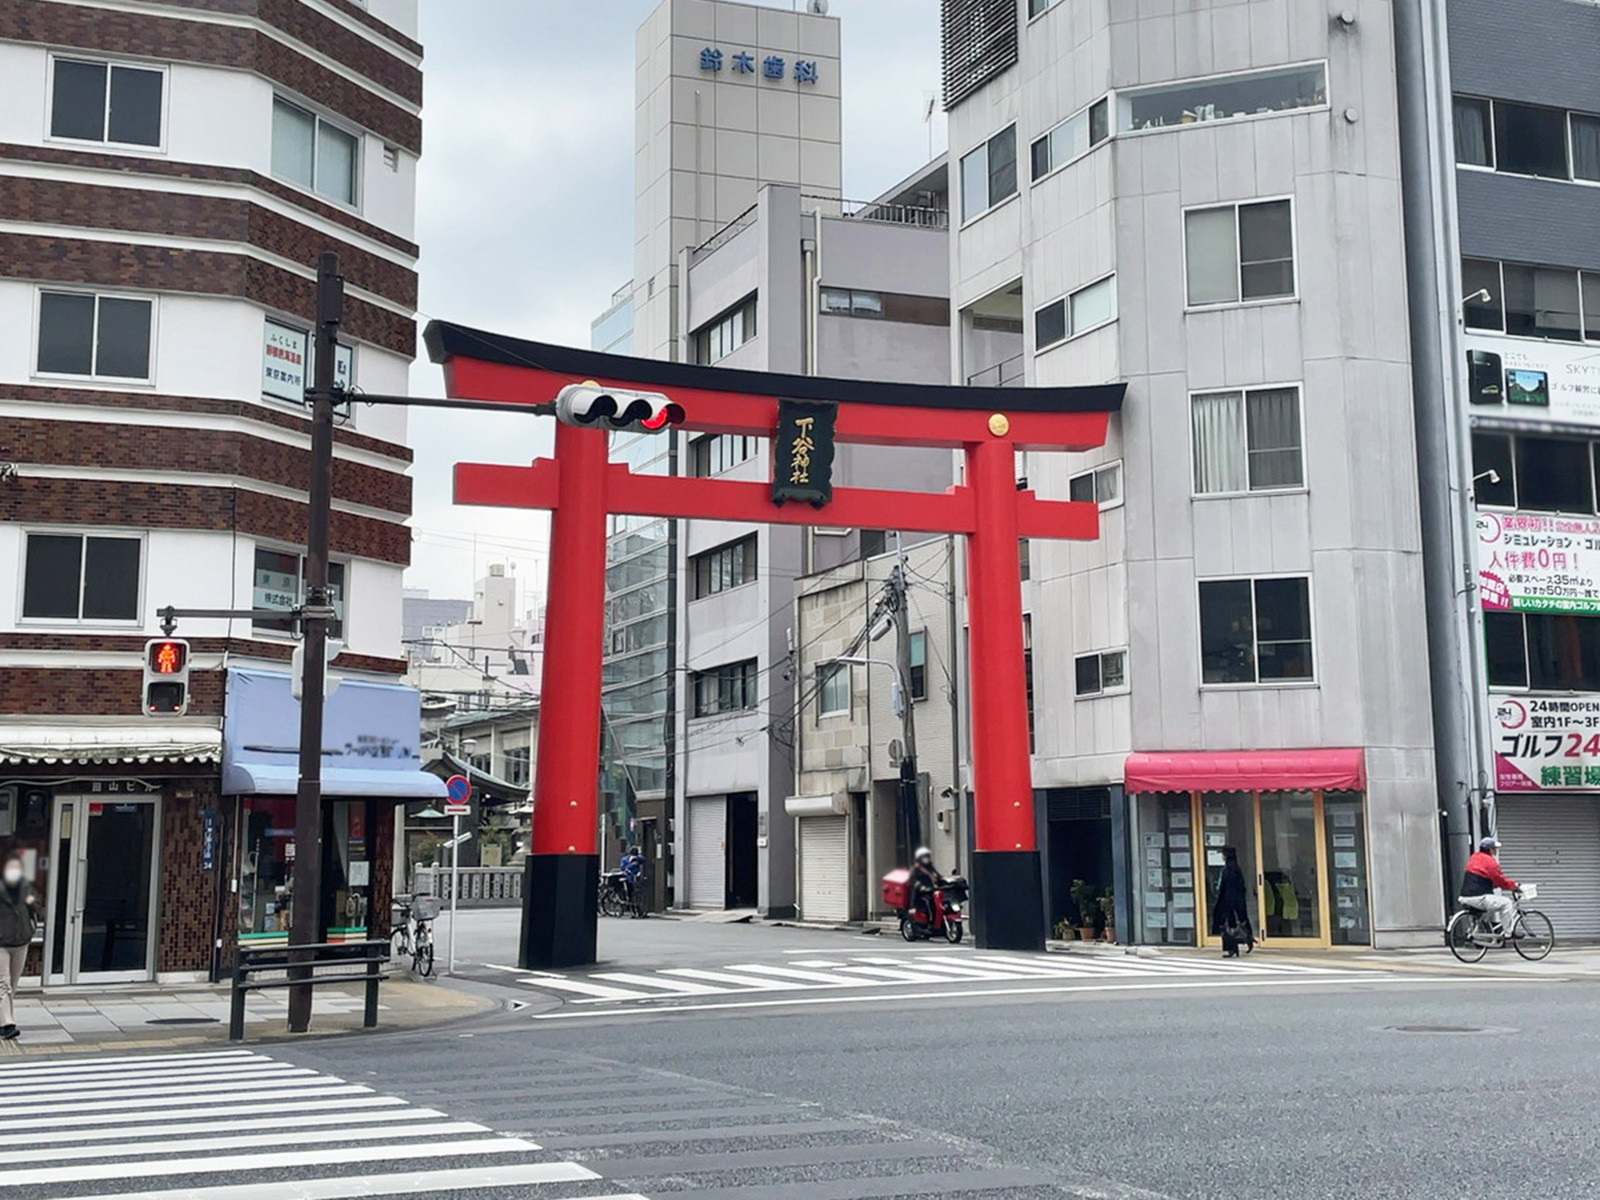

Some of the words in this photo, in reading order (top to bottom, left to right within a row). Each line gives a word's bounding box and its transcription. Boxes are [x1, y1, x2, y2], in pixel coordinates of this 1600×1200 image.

[699, 46, 819, 85] 鈴木歯科
[270, 334, 297, 349] ふくしま
[790, 416, 815, 485] 下谷神社
[1513, 598, 1600, 611] 新しいカタチの室内ゴルフ
[1529, 699, 1600, 713] 24時間OPEN
[1500, 733, 1600, 758] ゴルフ24
